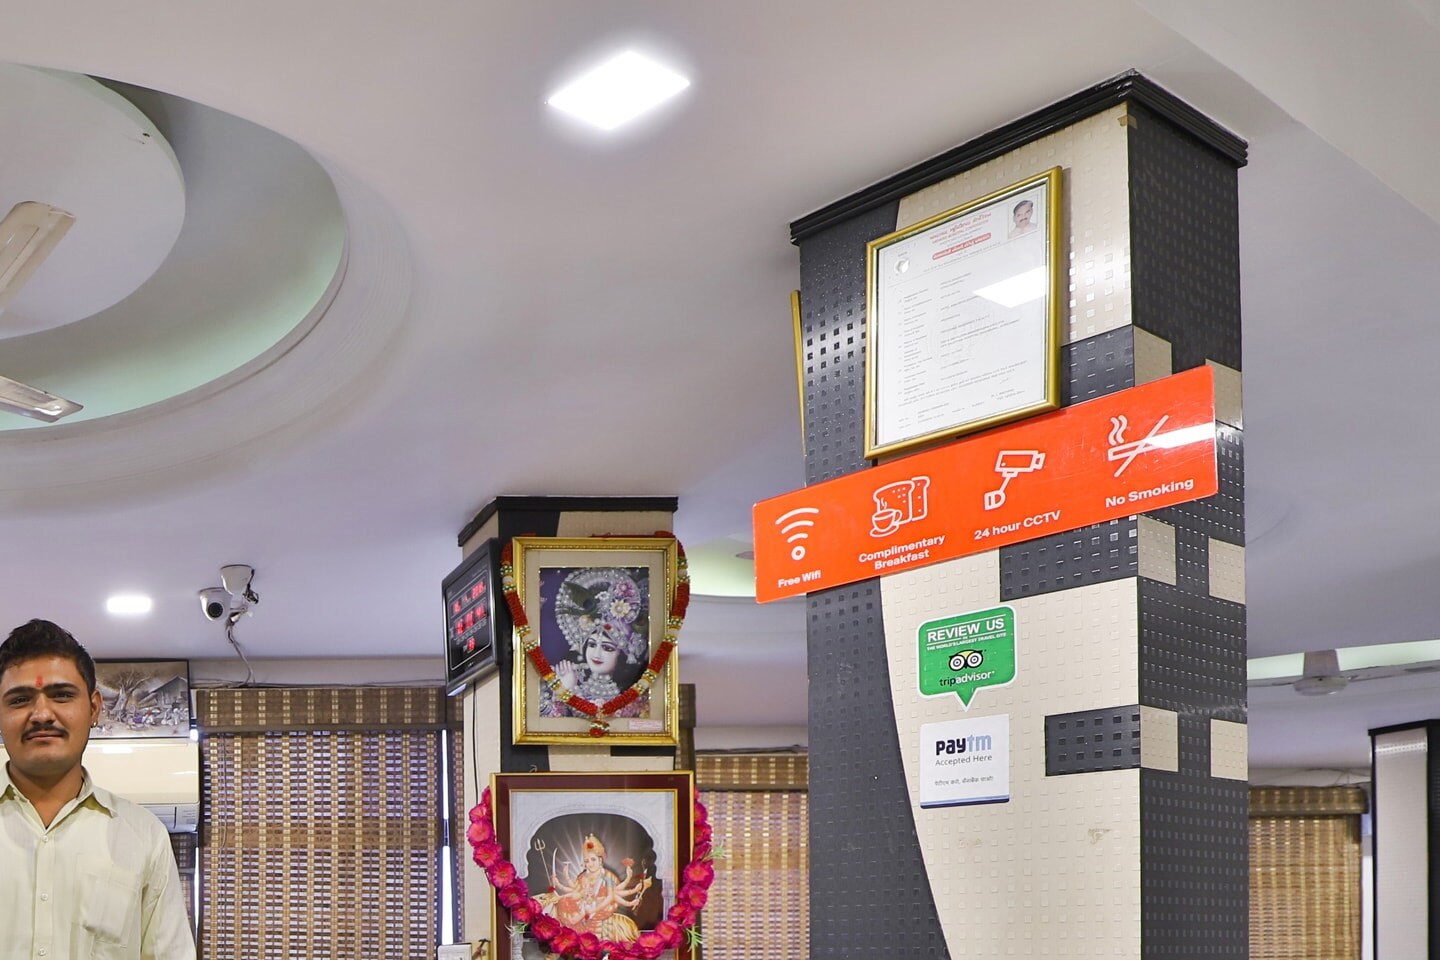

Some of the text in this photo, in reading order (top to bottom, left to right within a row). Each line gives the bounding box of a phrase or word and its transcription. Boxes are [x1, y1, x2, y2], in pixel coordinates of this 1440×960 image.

[1105, 479, 1194, 508] No Smoking
[974, 510, 1061, 540] 24 hour CCTV
[858, 535, 946, 563] Complimentary
[874, 549, 930, 570] Breakfast
[777, 569, 822, 588] Free Wifi
[927, 618, 1005, 643] REVIEW US
[939, 671, 992, 687] tripadvisor
[935, 756, 971, 766] Accepted
